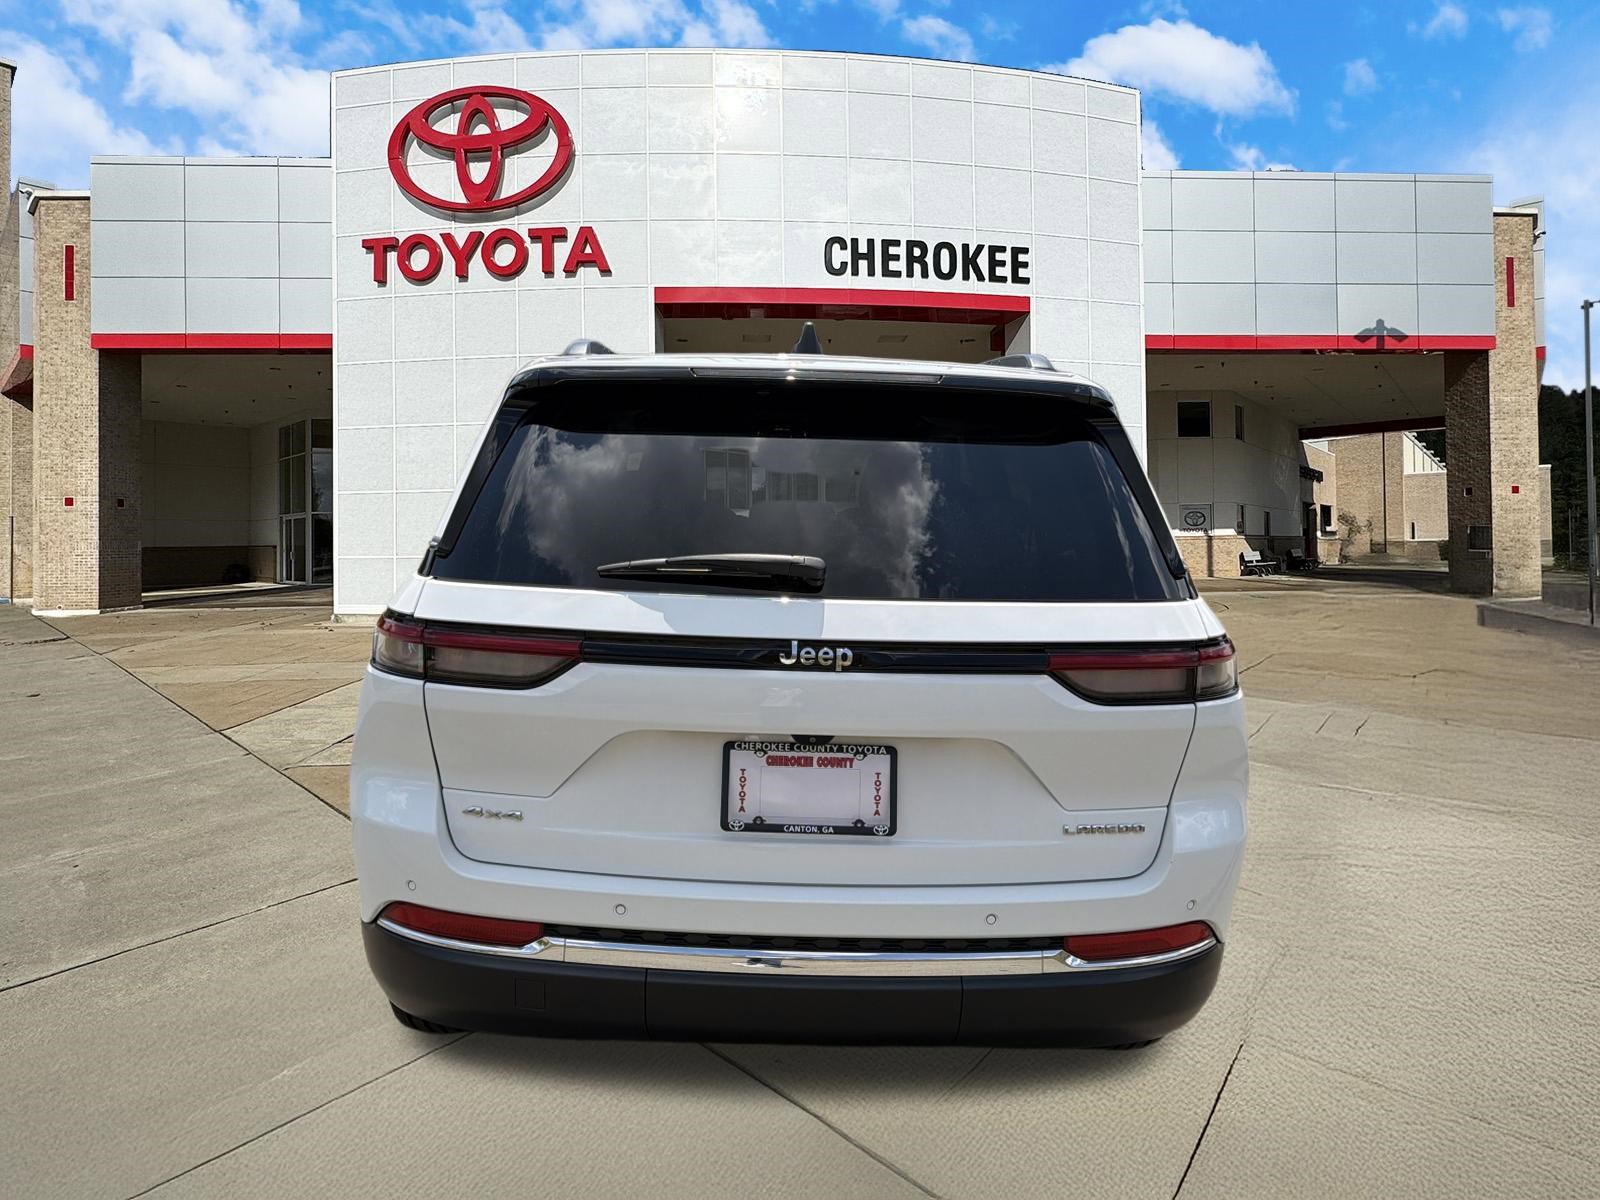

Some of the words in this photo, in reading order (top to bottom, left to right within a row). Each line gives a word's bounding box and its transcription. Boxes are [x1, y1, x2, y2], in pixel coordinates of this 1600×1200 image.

[362, 226, 612, 286] TOYOTA
[824, 236, 1030, 284] CHEROKEE
[779, 640, 853, 672] Jeep
[734, 741, 790, 752] CHEROKEE
[793, 743, 839, 753] COUNTY
[843, 745, 887, 755] TOYOTA
[766, 755, 814, 768] CHEROKEE
[816, 756, 855, 768] COUNTY
[738, 768, 747, 813] TOYOTA
[873, 772, 882, 817] TOYOTA
[783, 824, 820, 834] CANTON,
[822, 825, 834, 834] GA
[1063, 824, 1145, 834] LAREDO
